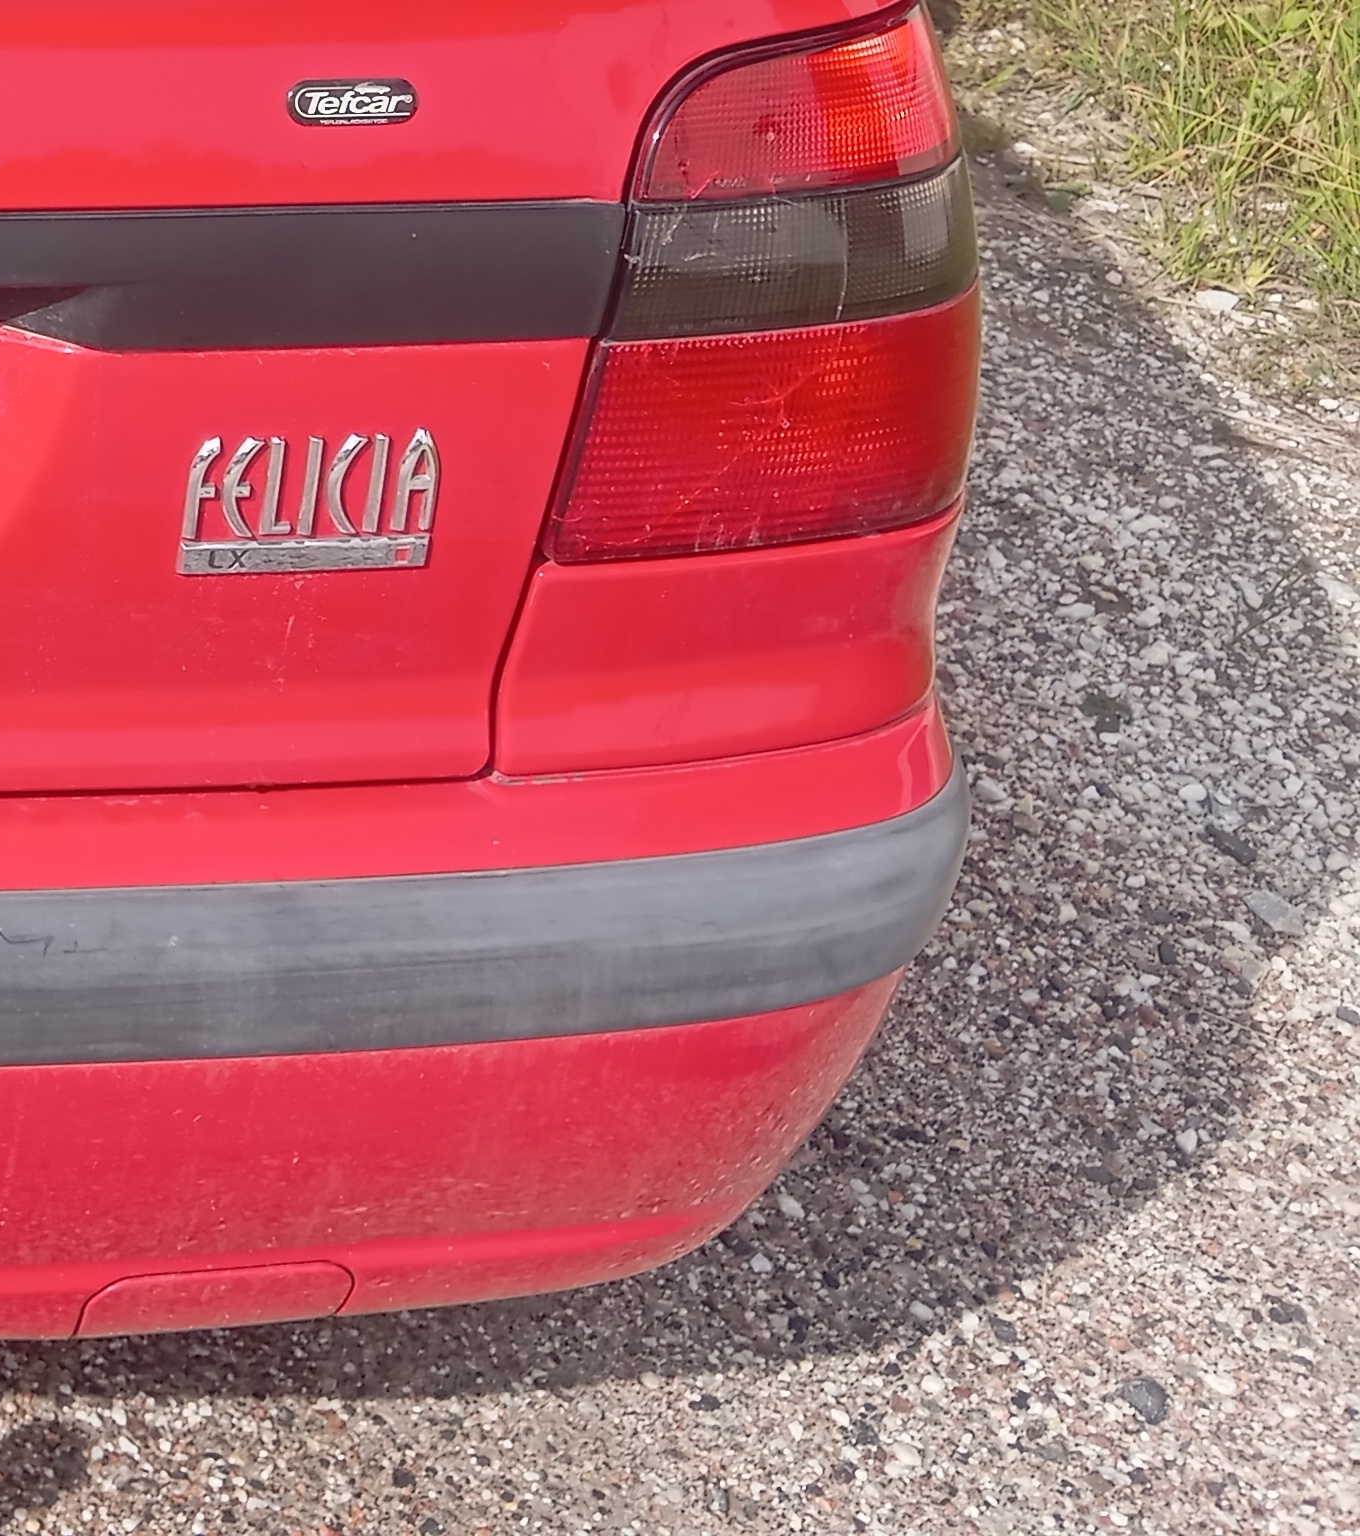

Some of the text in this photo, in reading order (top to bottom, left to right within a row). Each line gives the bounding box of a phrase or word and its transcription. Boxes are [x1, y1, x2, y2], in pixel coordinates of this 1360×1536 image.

[304, 90, 404, 115] Tefcar
[182, 428, 440, 539] FELICIA
[208, 549, 249, 569] LX
